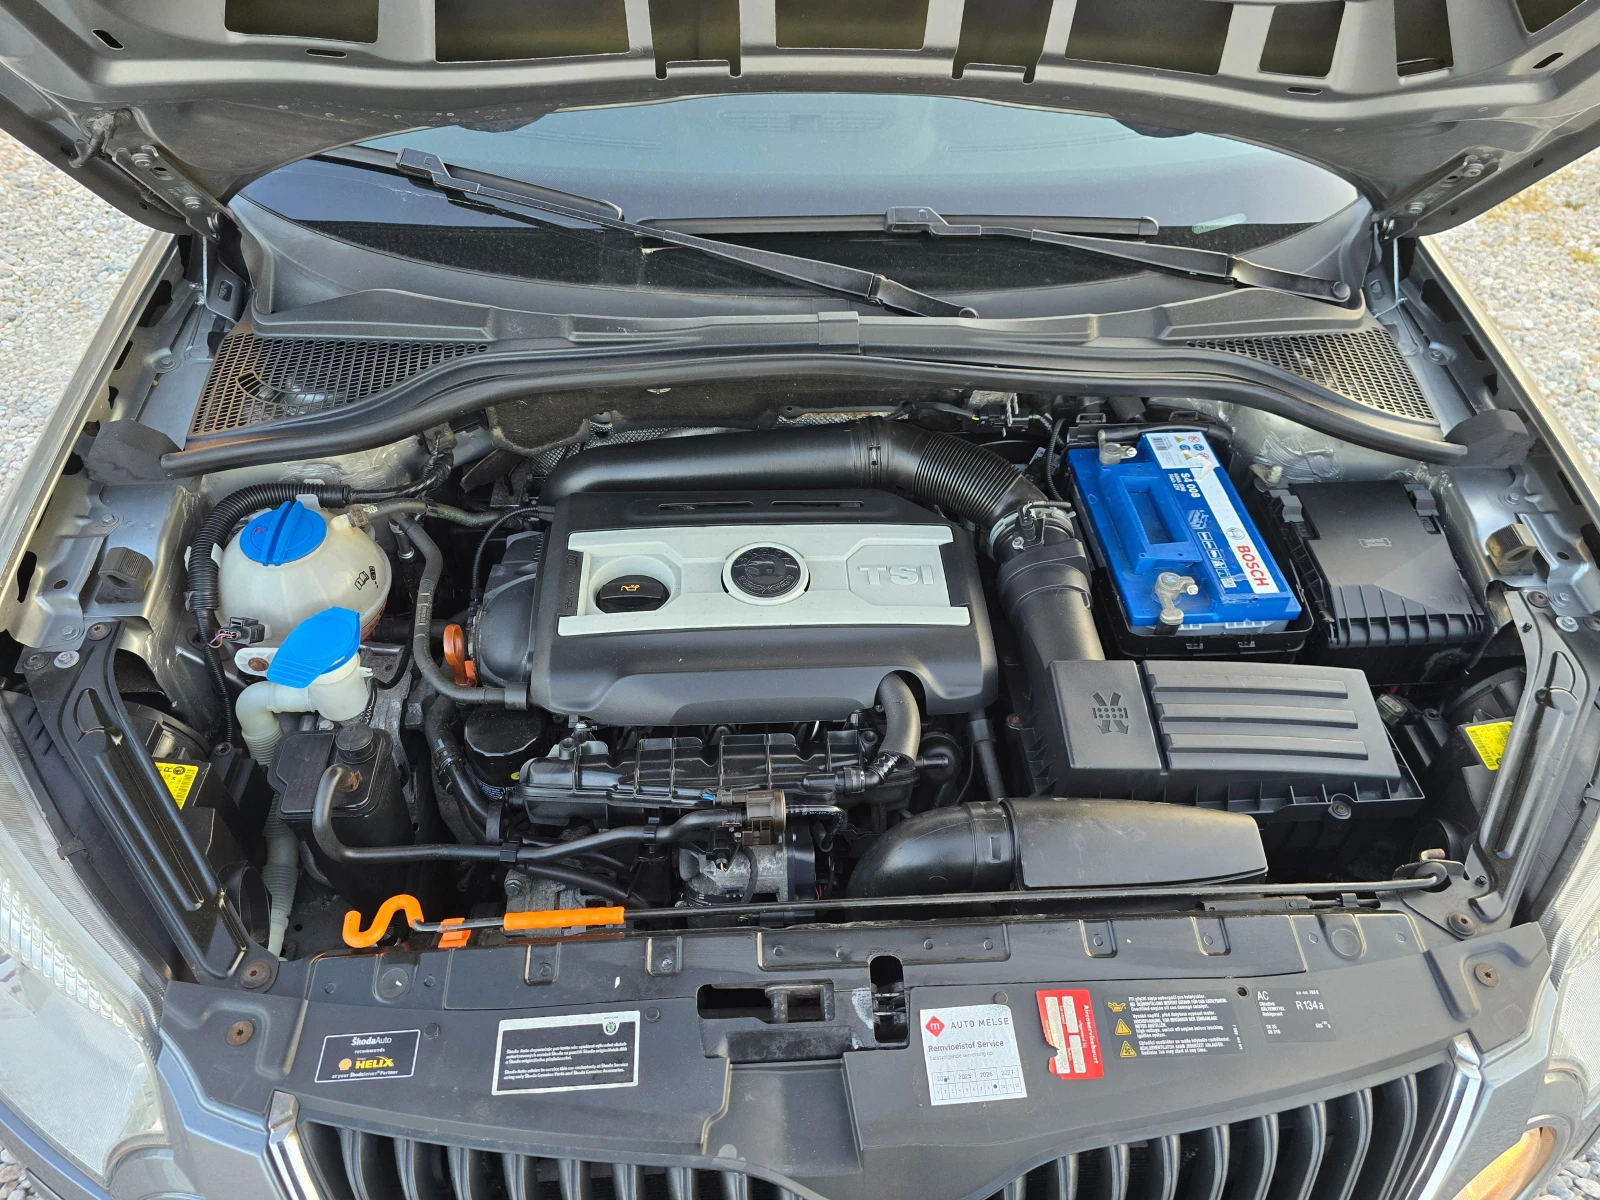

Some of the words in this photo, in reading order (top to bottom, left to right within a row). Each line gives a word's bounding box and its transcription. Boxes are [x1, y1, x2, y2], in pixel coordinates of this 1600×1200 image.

[1181, 473, 1193, 482] S4
[1186, 484, 1200, 497] 008
[1236, 545, 1270, 586] BOSCH
[858, 565, 934, 585] TSI
[1257, 990, 1269, 1000] AC
[950, 1020, 975, 1029] AUTO
[978, 1017, 1009, 1027] MELSE
[1083, 1004, 1099, 1064] Aircoservicebeurt
[351, 1036, 392, 1046] ŠkodaAuto
[928, 1042, 975, 1052] Remvloeistof
[977, 1040, 1004, 1048] Service
[355, 1057, 394, 1069] HELIX
